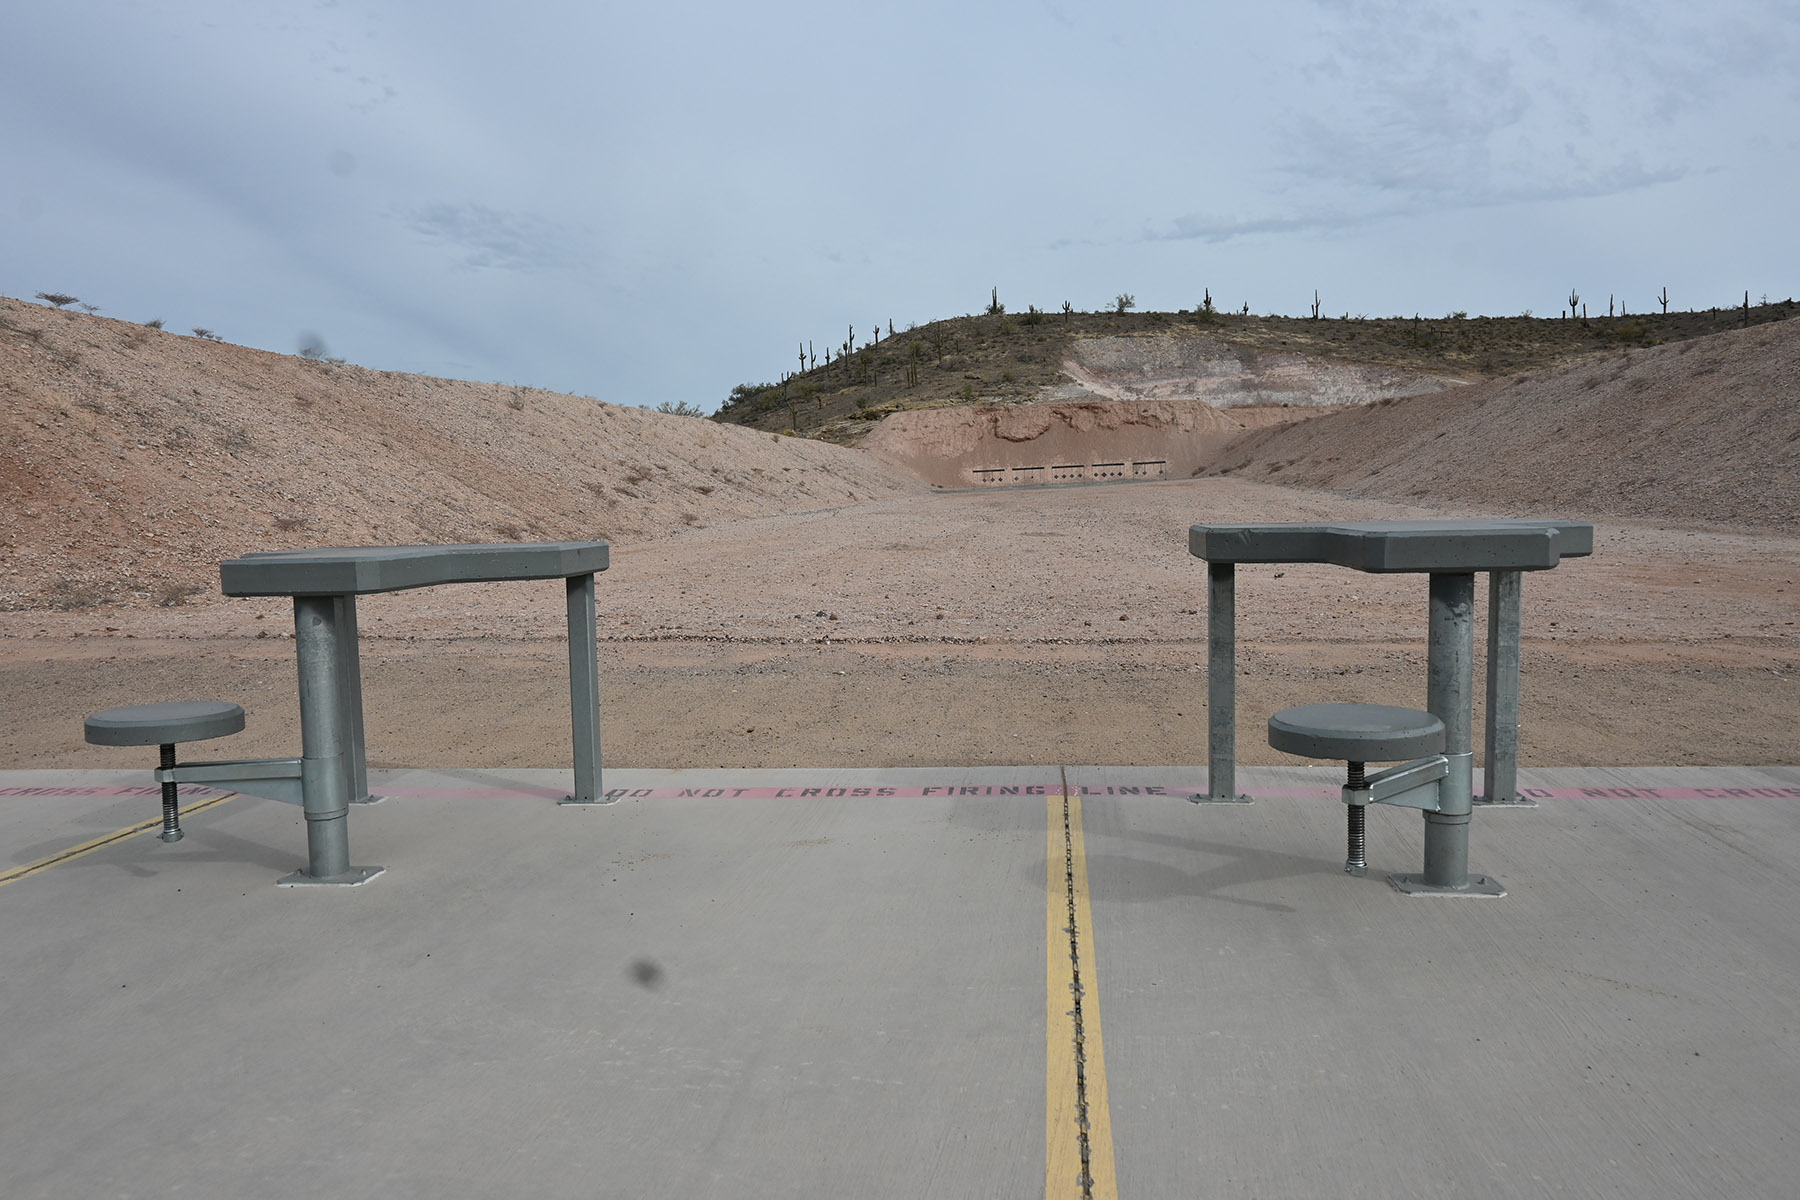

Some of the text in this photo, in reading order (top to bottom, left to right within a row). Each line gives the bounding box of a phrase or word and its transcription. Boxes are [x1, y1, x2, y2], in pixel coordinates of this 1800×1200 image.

[604, 786, 1168, 798] DO NOT CROSS FIRING LINE
[1580, 788, 1662, 798] NOT
